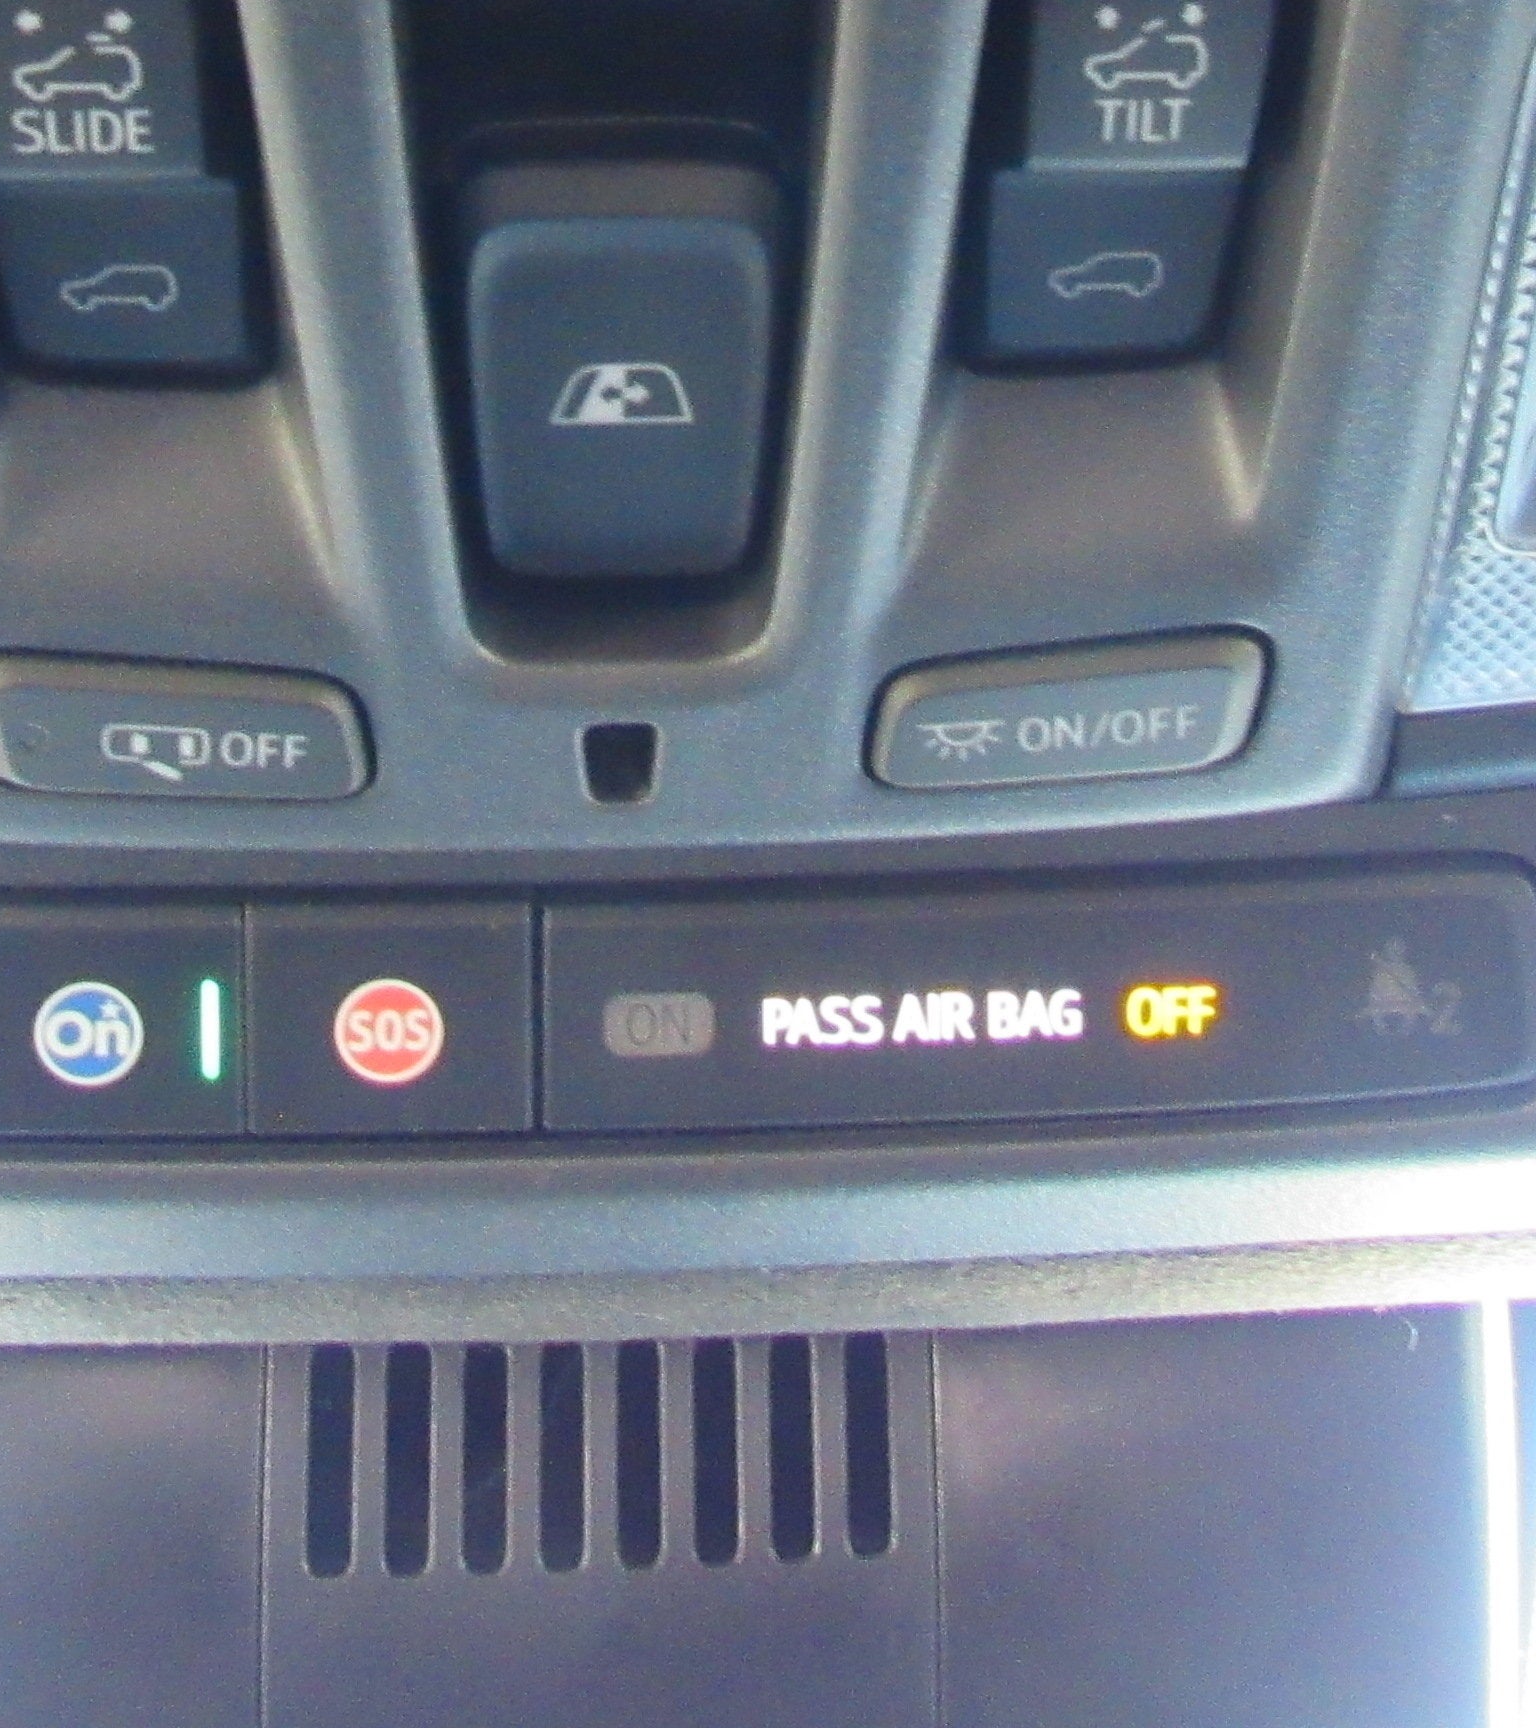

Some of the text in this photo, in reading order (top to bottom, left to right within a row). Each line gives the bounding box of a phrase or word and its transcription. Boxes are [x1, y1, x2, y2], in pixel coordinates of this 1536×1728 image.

[10, 107, 156, 155] SLIDE
[1094, 96, 1192, 144] TILT
[219, 730, 310, 769] OFF
[1015, 703, 1202, 754] ON/OFF
[44, 1006, 131, 1058] On
[344, 1005, 433, 1054] SOS
[624, 1001, 692, 1047] ON
[761, 982, 1218, 1046] PASS AIR BAG OFF
